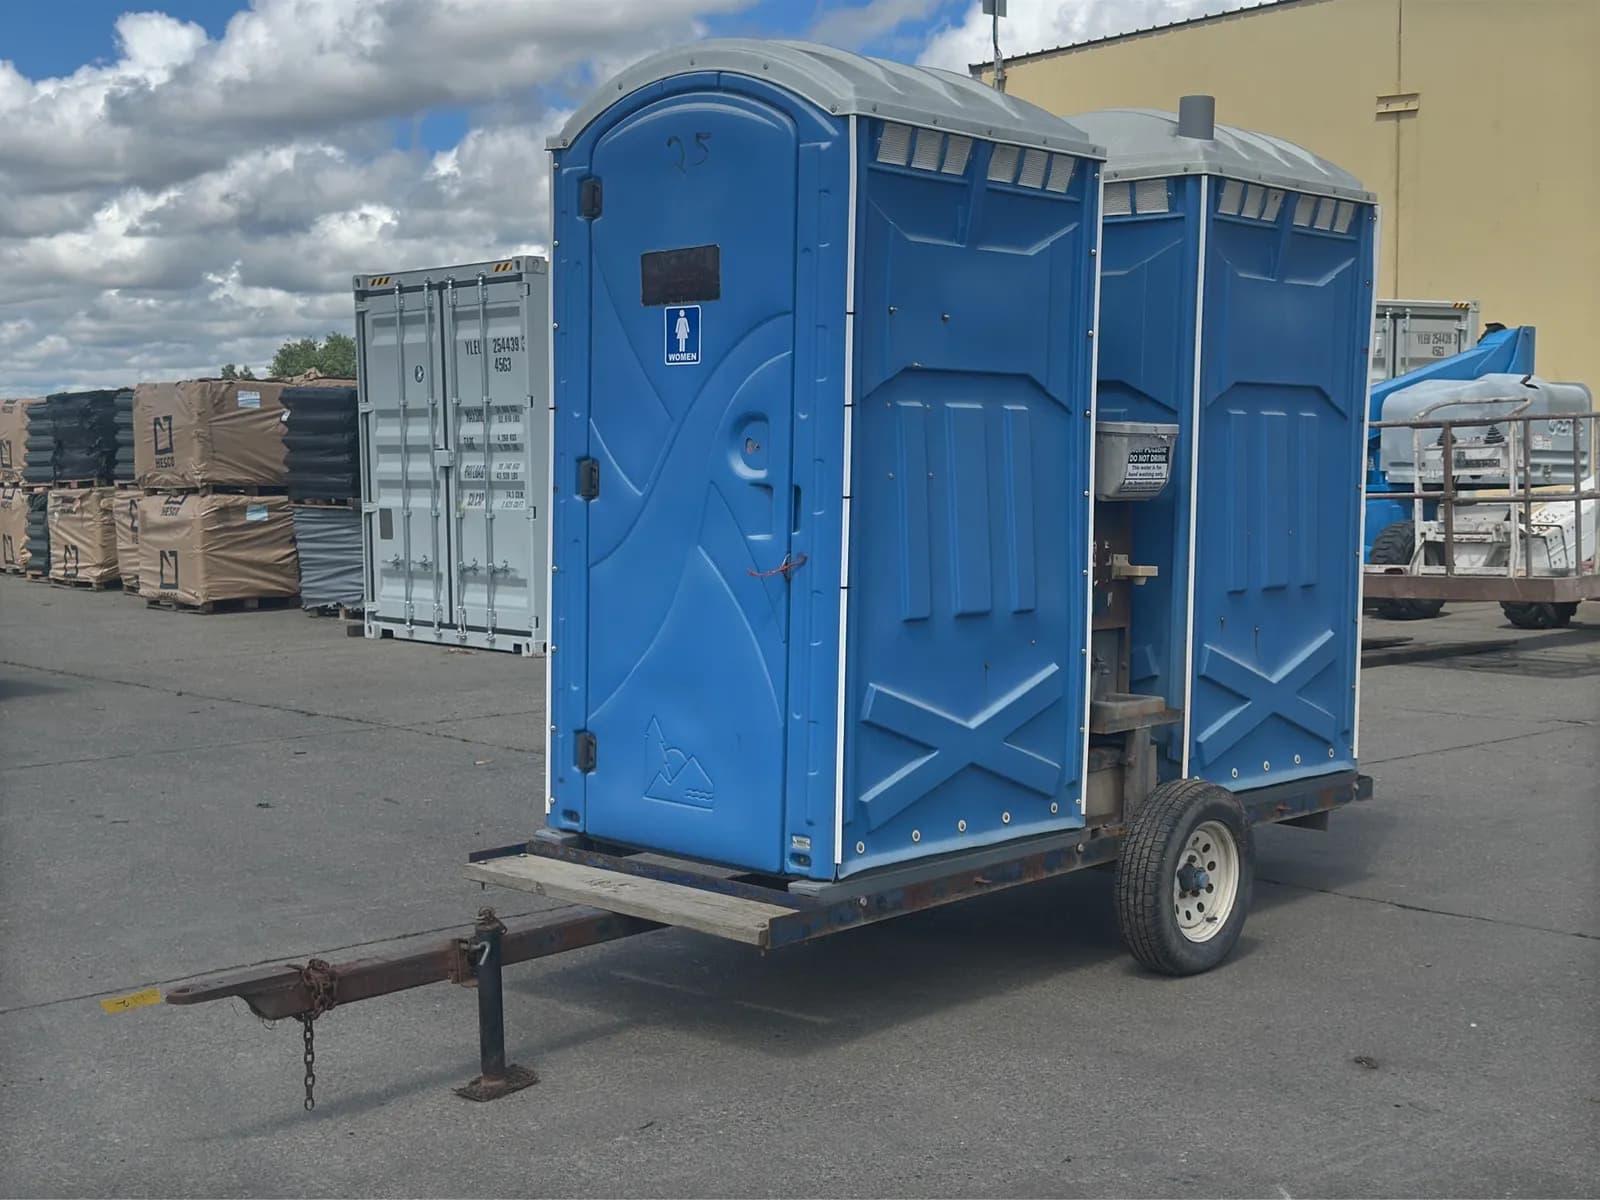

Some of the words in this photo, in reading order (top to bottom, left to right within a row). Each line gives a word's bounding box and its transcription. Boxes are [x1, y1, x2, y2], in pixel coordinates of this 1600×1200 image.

[493, 337, 520, 353] 254439
[668, 352, 697, 361] WOMEN
[155, 456, 175, 469] HESCO
[1129, 454, 1138, 462] DO
[1138, 454, 1150, 462] NOT
[1150, 454, 1167, 462] DRINK
